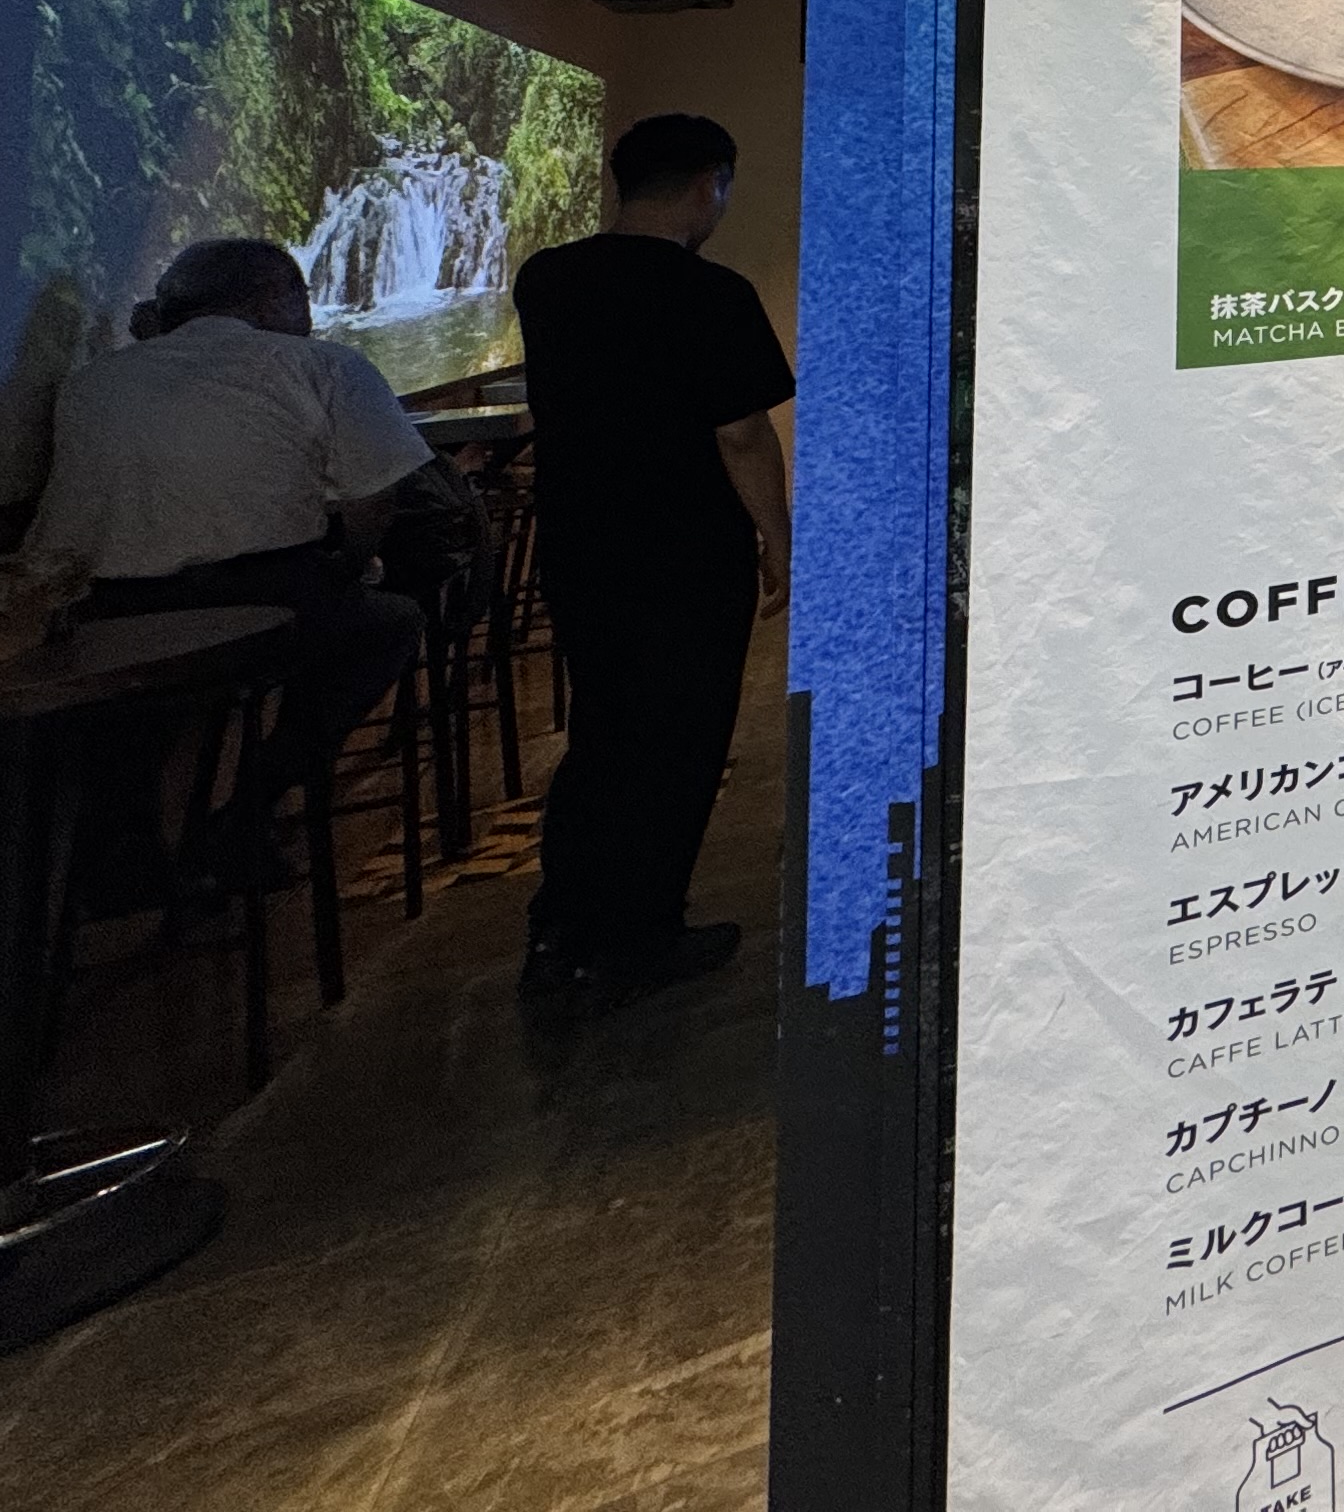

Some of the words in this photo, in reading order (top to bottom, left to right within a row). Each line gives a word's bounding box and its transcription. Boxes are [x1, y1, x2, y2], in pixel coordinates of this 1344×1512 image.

[1213, 319, 1324, 348] MATCHA
[1172, 663, 1310, 703] コーヒー
[1173, 704, 1285, 741] COFFEE
[1170, 803, 1322, 854] AMERICAN
[1169, 913, 1317, 966] ESPRESSO
[1167, 969, 1337, 1042] カフェラテ
[1167, 1036, 1262, 1078] CAFFE
[1165, 1078, 1338, 1157] カプチーノ
[1166, 1125, 1341, 1194] CAPCHINNO
[1166, 1272, 1234, 1316] MILK
